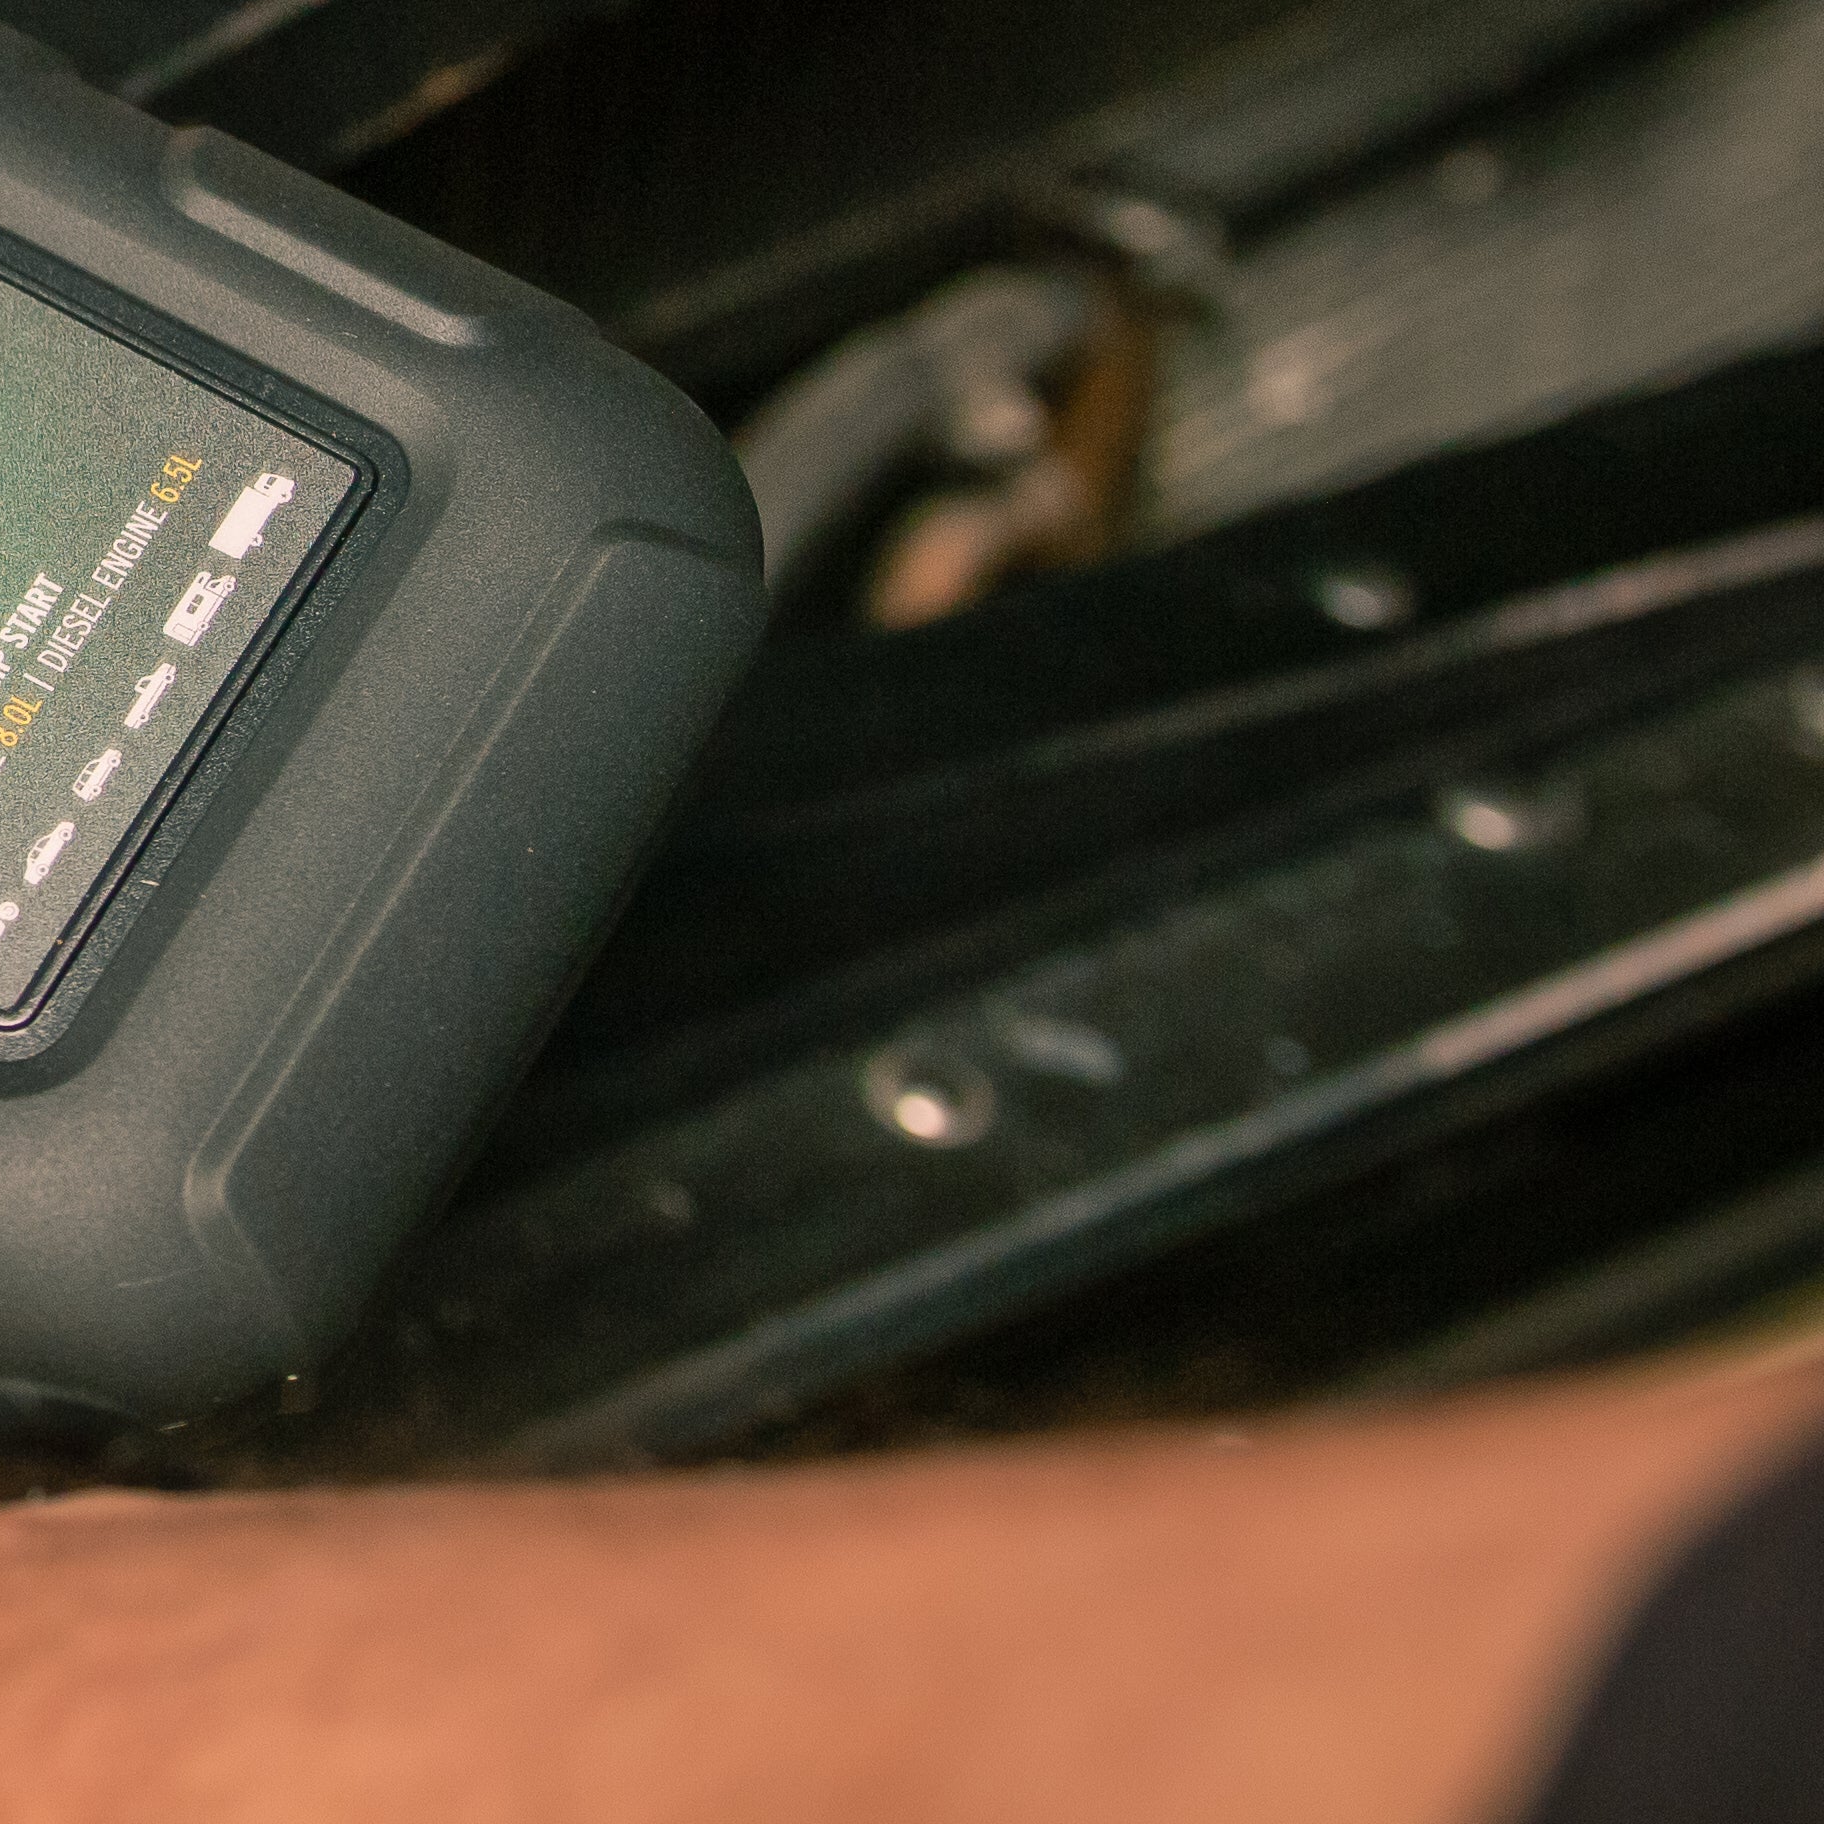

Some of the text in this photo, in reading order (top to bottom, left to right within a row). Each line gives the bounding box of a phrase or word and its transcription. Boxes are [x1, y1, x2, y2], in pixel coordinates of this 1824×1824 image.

[0, 572, 65, 649] START
[36, 593, 112, 673] DIESEL
[91, 500, 169, 591] ENGINE
[150, 455, 203, 503] 6.5L
